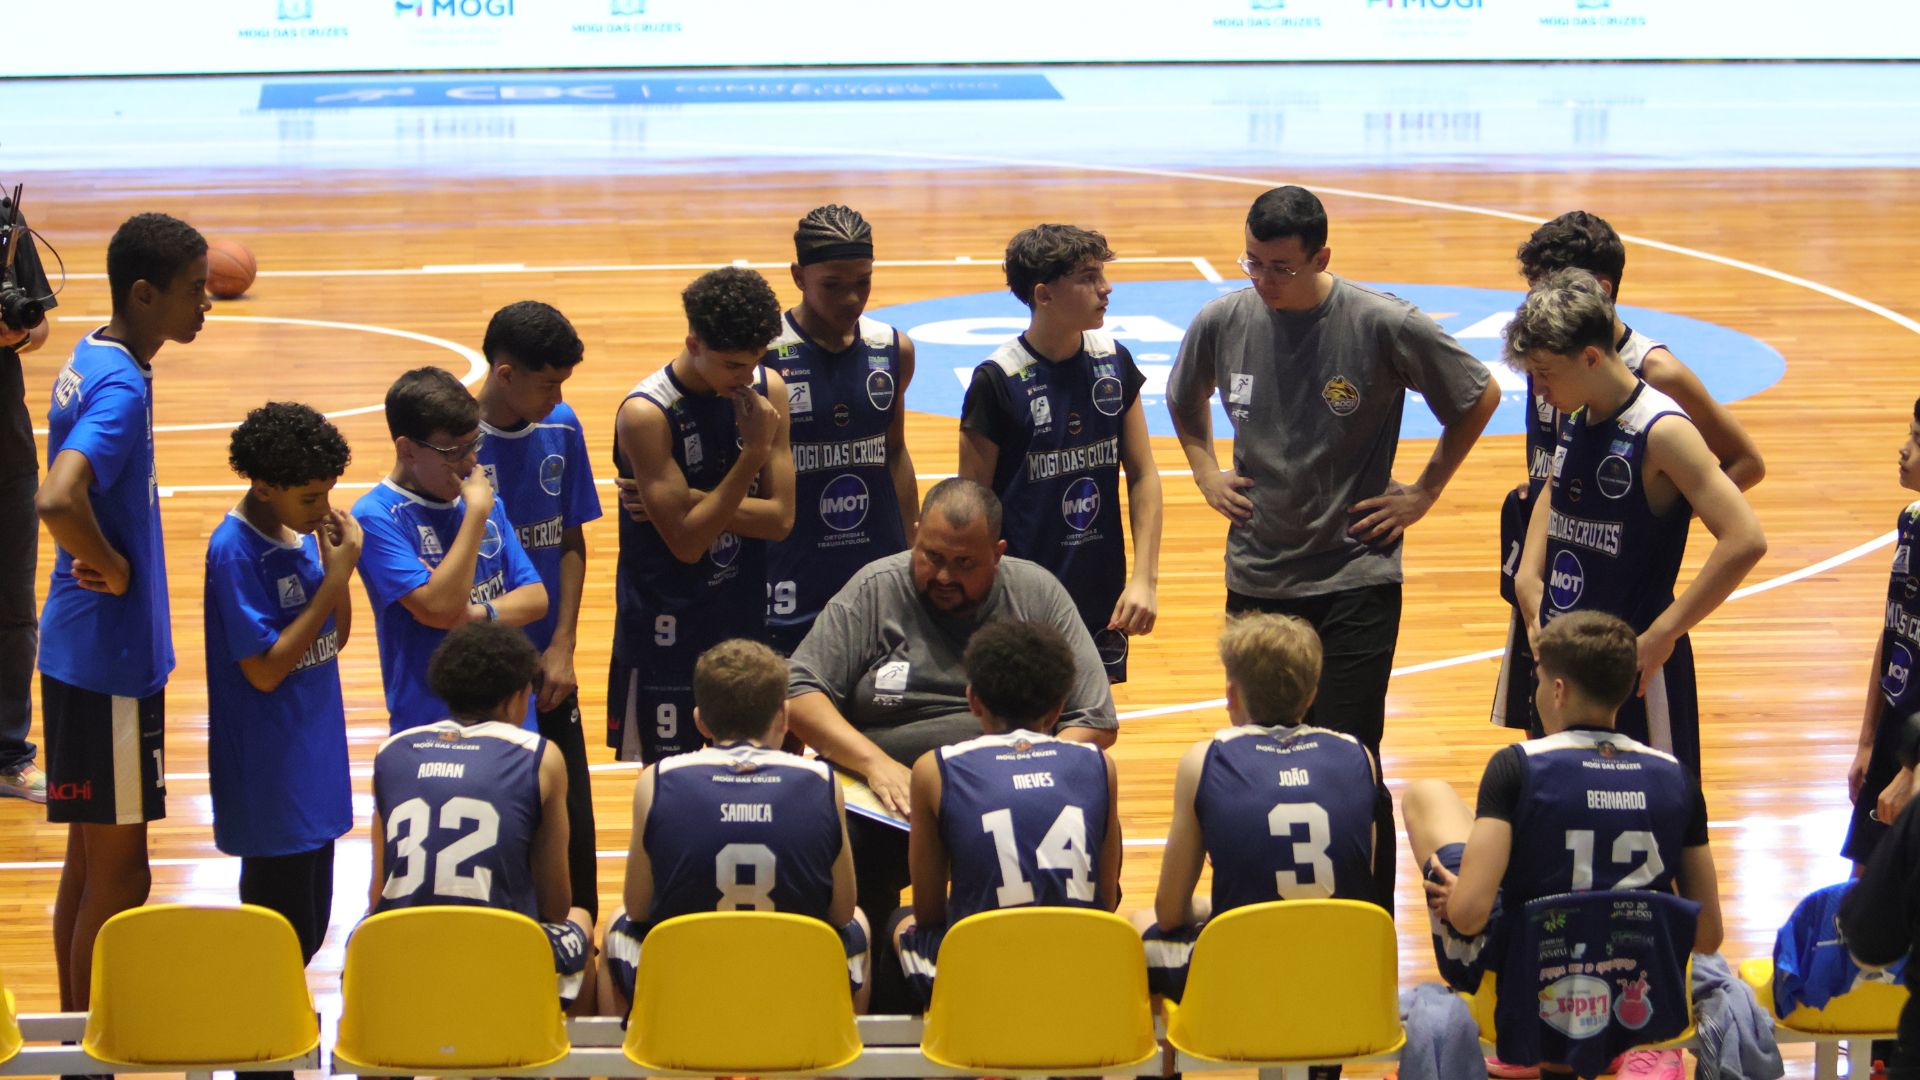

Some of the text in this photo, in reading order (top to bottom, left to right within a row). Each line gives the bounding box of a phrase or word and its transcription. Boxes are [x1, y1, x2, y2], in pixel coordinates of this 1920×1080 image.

[824, 444, 849, 467] DAS
[1029, 452, 1059, 481] MOGI
[1061, 449, 1084, 473] DAS
[822, 494, 868, 514] IMOT
[1575, 520, 1620, 556] CRUZES
[654, 614, 677, 646] 9
[656, 703, 677, 738] 9
[417, 761, 465, 780] ADRIAN
[1012, 771, 1055, 790] MEVES
[1278, 767, 1310, 787] JOÃO
[720, 802, 773, 823] SAMUCA
[1586, 790, 1647, 810] BERNARDO
[382, 796, 500, 902] 32
[981, 805, 1096, 908] 14
[1267, 802, 1336, 901] 3
[1565, 829, 1665, 892] 12
[715, 843, 777, 913] 8
